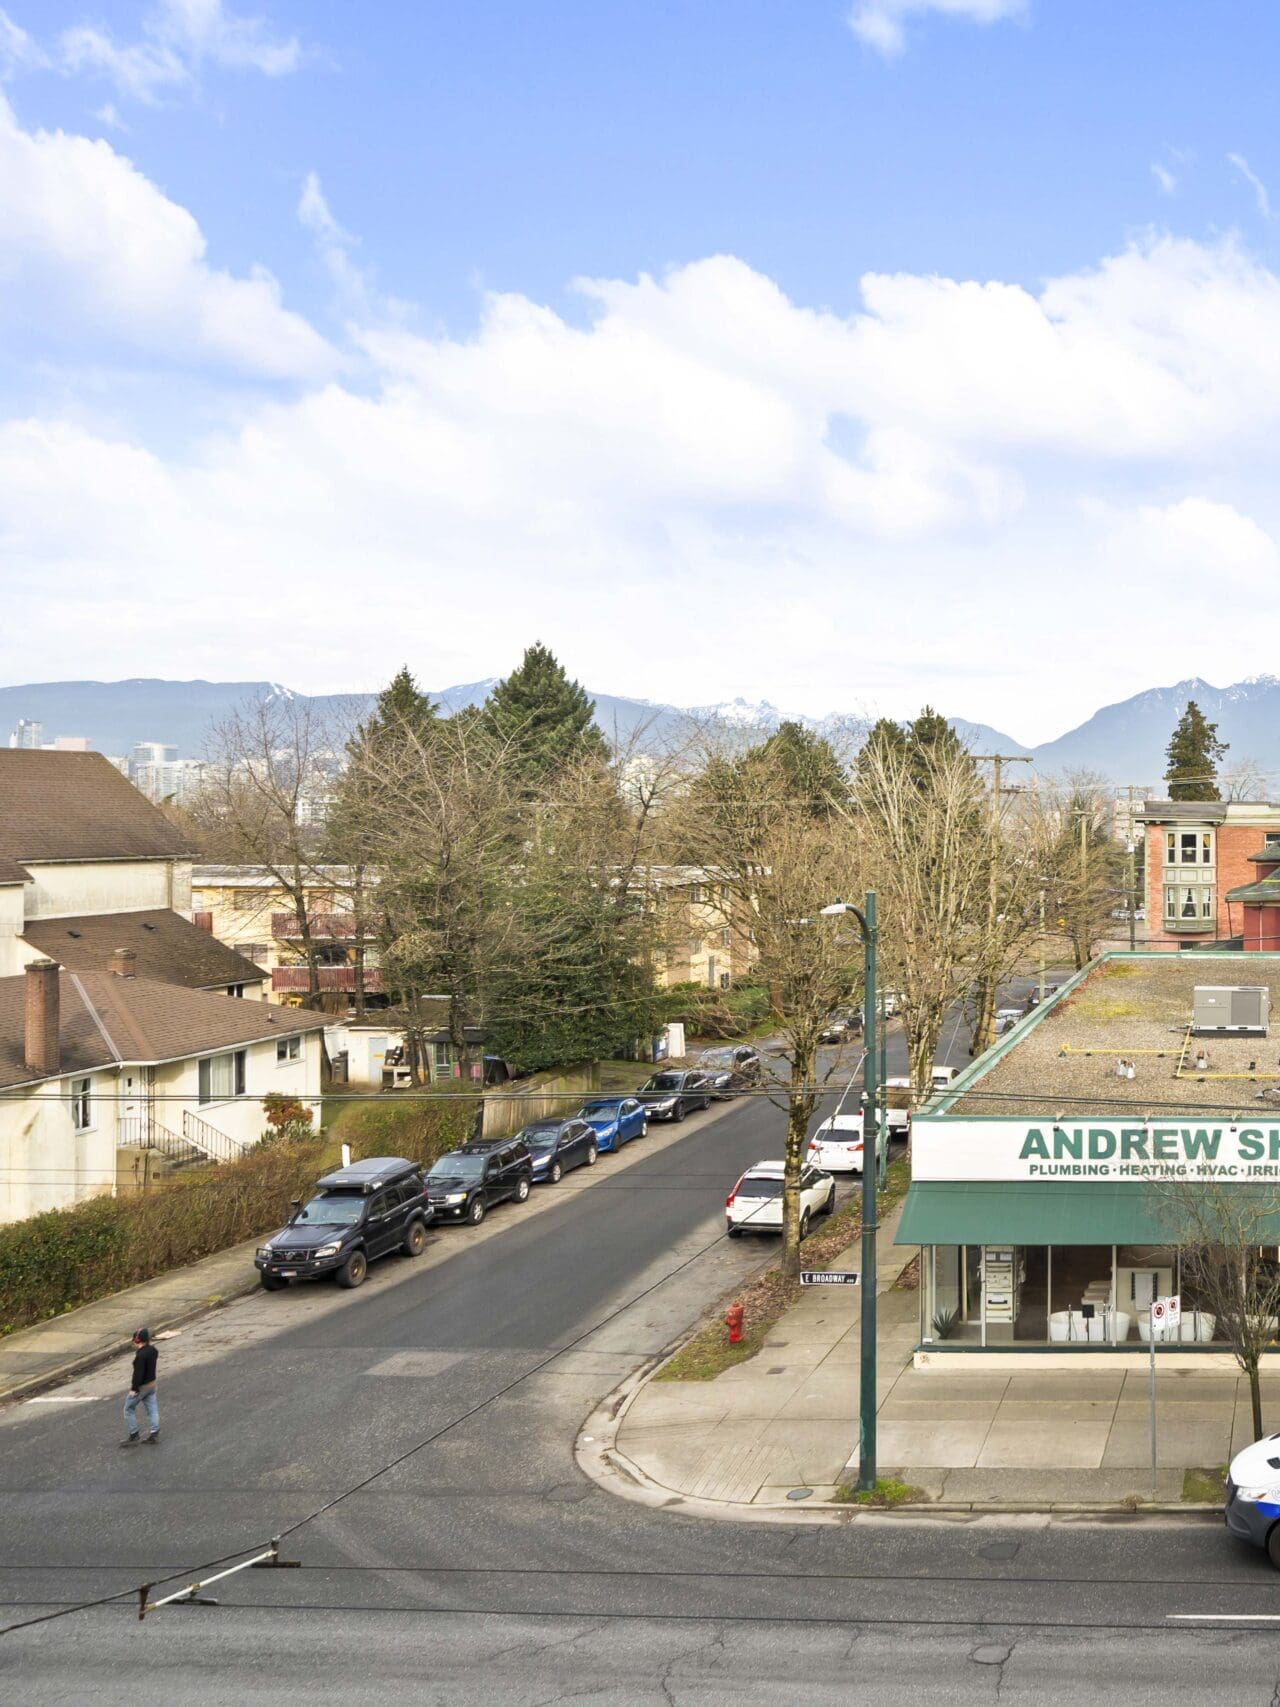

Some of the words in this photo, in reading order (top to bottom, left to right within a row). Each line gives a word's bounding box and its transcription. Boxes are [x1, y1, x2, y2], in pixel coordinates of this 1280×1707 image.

[1019, 1129, 1223, 1160] ANDREW
[1029, 1164, 1110, 1176] PLUMBING
[1119, 1164, 1187, 1177] HEATING
[1196, 1164, 1239, 1177] HVAC
[805, 1274, 810, 1283] E
[812, 1274, 846, 1283] BROADWAY
